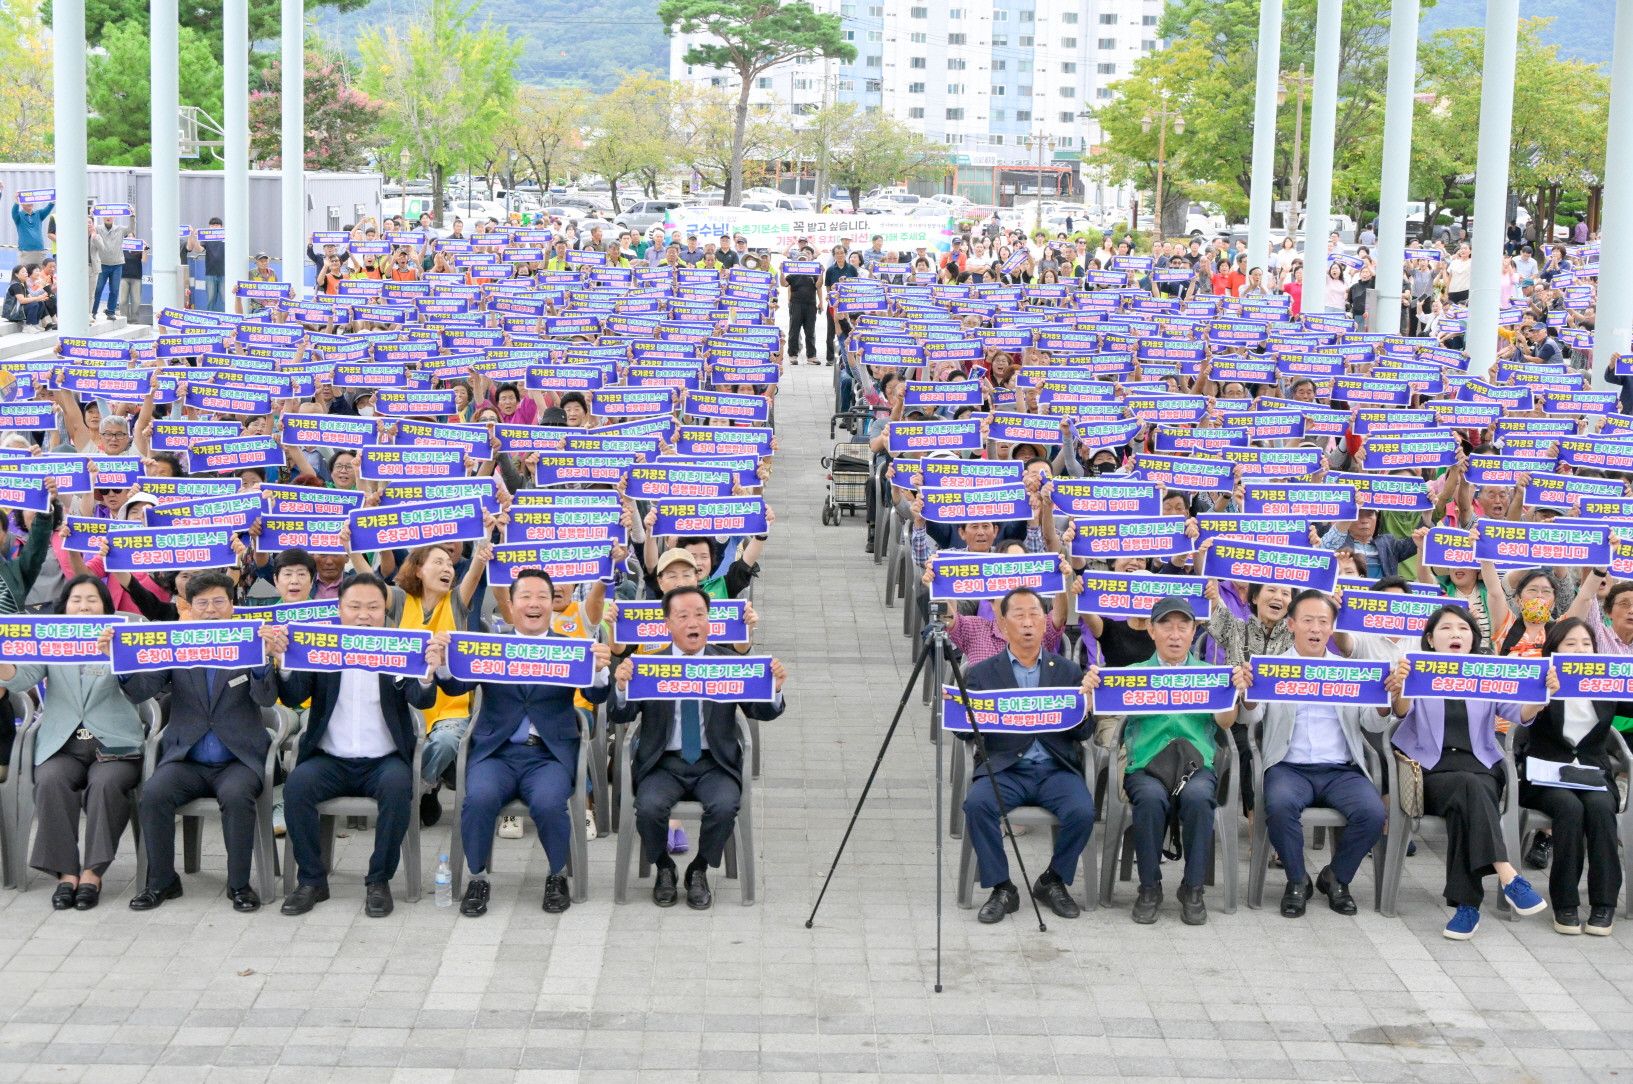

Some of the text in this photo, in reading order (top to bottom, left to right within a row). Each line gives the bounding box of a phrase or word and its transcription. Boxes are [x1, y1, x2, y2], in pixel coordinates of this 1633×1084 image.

[732, 223, 790, 234] 농촌기본소득
[793, 221, 804, 233] 꼭
[807, 222, 827, 232] 받고
[829, 220, 871, 231] 싶습니다.
[900, 231, 927, 241] 주세요
[596, 392, 668, 403] 국가공모 농어촌기본소득
[604, 403, 661, 413] 순창이 실행합니다!
[287, 418, 373, 434] 국가공모 농어촌기본소득
[895, 424, 975, 436] 국가공모 농어촌기본소득
[297, 430, 363, 444] 순창이 실행합니다!
[682, 430, 768, 443] 국가공모 농어촌기본소득
[907, 435, 963, 447] 순창군이 답이다!
[192, 439, 277, 460] 국가공모 농어촌기본소득
[692, 443, 757, 454] 순창이 실행합니다!
[1369, 442, 1455, 453] 국가공모 농어촌기본소득
[1562, 440, 1593, 452] 국가공모
[206, 451, 266, 466] 순창군이 답이다!
[367, 451, 460, 463] 국가공모 농어촌기본소득
[1382, 453, 1441, 464] 순창군이 답이다!
[1573, 453, 1633, 466] 순창군이 답이다!
[378, 464, 450, 475] 순창이 실행합니다!
[632, 468, 730, 484] 국가공모 농어촌기본소득
[642, 482, 719, 496] 순창이 실행합니다!
[927, 489, 1026, 504] 국가공모 농어촌기본소득
[1057, 484, 1154, 498] 국가공모 농어촌기본소득
[1251, 489, 1351, 502] 국가공모 농어촌기본소득
[660, 502, 761, 517] 국가공모 농어촌기본소득
[938, 503, 1015, 517] 순창이 실행합니다!
[1072, 499, 1139, 511] 순창군이 답이다!
[1262, 503, 1340, 515] 순창이 실행합니다!
[357, 504, 475, 529] 국가공모 농어촌기본소득
[514, 512, 620, 525] 국가공모 농어촌기본소득
[675, 517, 745, 530] 순창군이 답이다!
[266, 520, 305, 532] 국가공모
[377, 522, 458, 543] 순창군이 답이다!
[526, 527, 608, 539] 순창이 실행합니다!
[1079, 522, 1185, 538] 국가공모 농어촌기본소득
[1200, 520, 1306, 532] 국가공모 농어촌기본소득
[112, 532, 228, 549] 국가공모 농어촌기본소득
[278, 533, 308, 546] 순창이
[1485, 525, 1603, 544] 국가공모 농어촌기본소득
[1091, 537, 1173, 552] 순창이 실행합니다!
[1498, 542, 1588, 559] 순창이 실행합니다!
[132, 548, 211, 564] 순창군이 답이다!
[496, 545, 612, 564] 국가공모 농어촌기본소득
[1216, 545, 1330, 569] 국가공모 농어촌기본소득
[1444, 549, 1474, 562] 순창이
[544, 562, 600, 577] 실행합니다!
[939, 560, 1055, 578] 국가공모 농어촌기본소득
[1231, 562, 1310, 581] 순창군이 답이다!
[953, 576, 1042, 593] 순창이 실행합니다!
[1087, 578, 1203, 596] 국가공모 농어촌기본소득
[1099, 594, 1131, 608] 순창이
[1347, 597, 1388, 612] 국가공모
[276, 605, 339, 622] 농어촌기본소
[623, 608, 666, 622] 국가공모
[1363, 614, 1401, 629] 순창군이
[0, 623, 33, 638] 가공모
[120, 627, 254, 647] 국가공모 농어촌기본소득
[637, 622, 669, 637] 순창이
[3, 641, 102, 656] 순창이 실행합니다
[293, 631, 422, 653] 국가공모 농어촌기본소득
[137, 646, 239, 663] 순창이 실행합니다!
[457, 640, 585, 661] 국가공모 농어촌기본소득
[308, 650, 407, 667] 순창이 실행합니다!
[471, 659, 570, 677] 순창이 실행합니다!
[637, 663, 764, 679] 국가공모 농어촌기본소득
[1258, 663, 1382, 682] 국가공모 농어촌기본소득
[1414, 660, 1541, 679] 국가공모 농어촌기본소득
[1561, 662, 1606, 676] 국가공모
[658, 680, 744, 694] 순창군이 답이다!
[1103, 674, 1230, 688] 국가공모 농어촌기본소득
[1275, 681, 1361, 696] 순창군이 답이다!
[1432, 677, 1520, 694] 순창군이 답이다!
[1579, 678, 1625, 692] 순창군이
[998, 695, 1076, 712] 농어촌기본소득
[1123, 690, 1210, 704] 순창군이 답이다!
[1002, 712, 1062, 726] 실행합니다!
